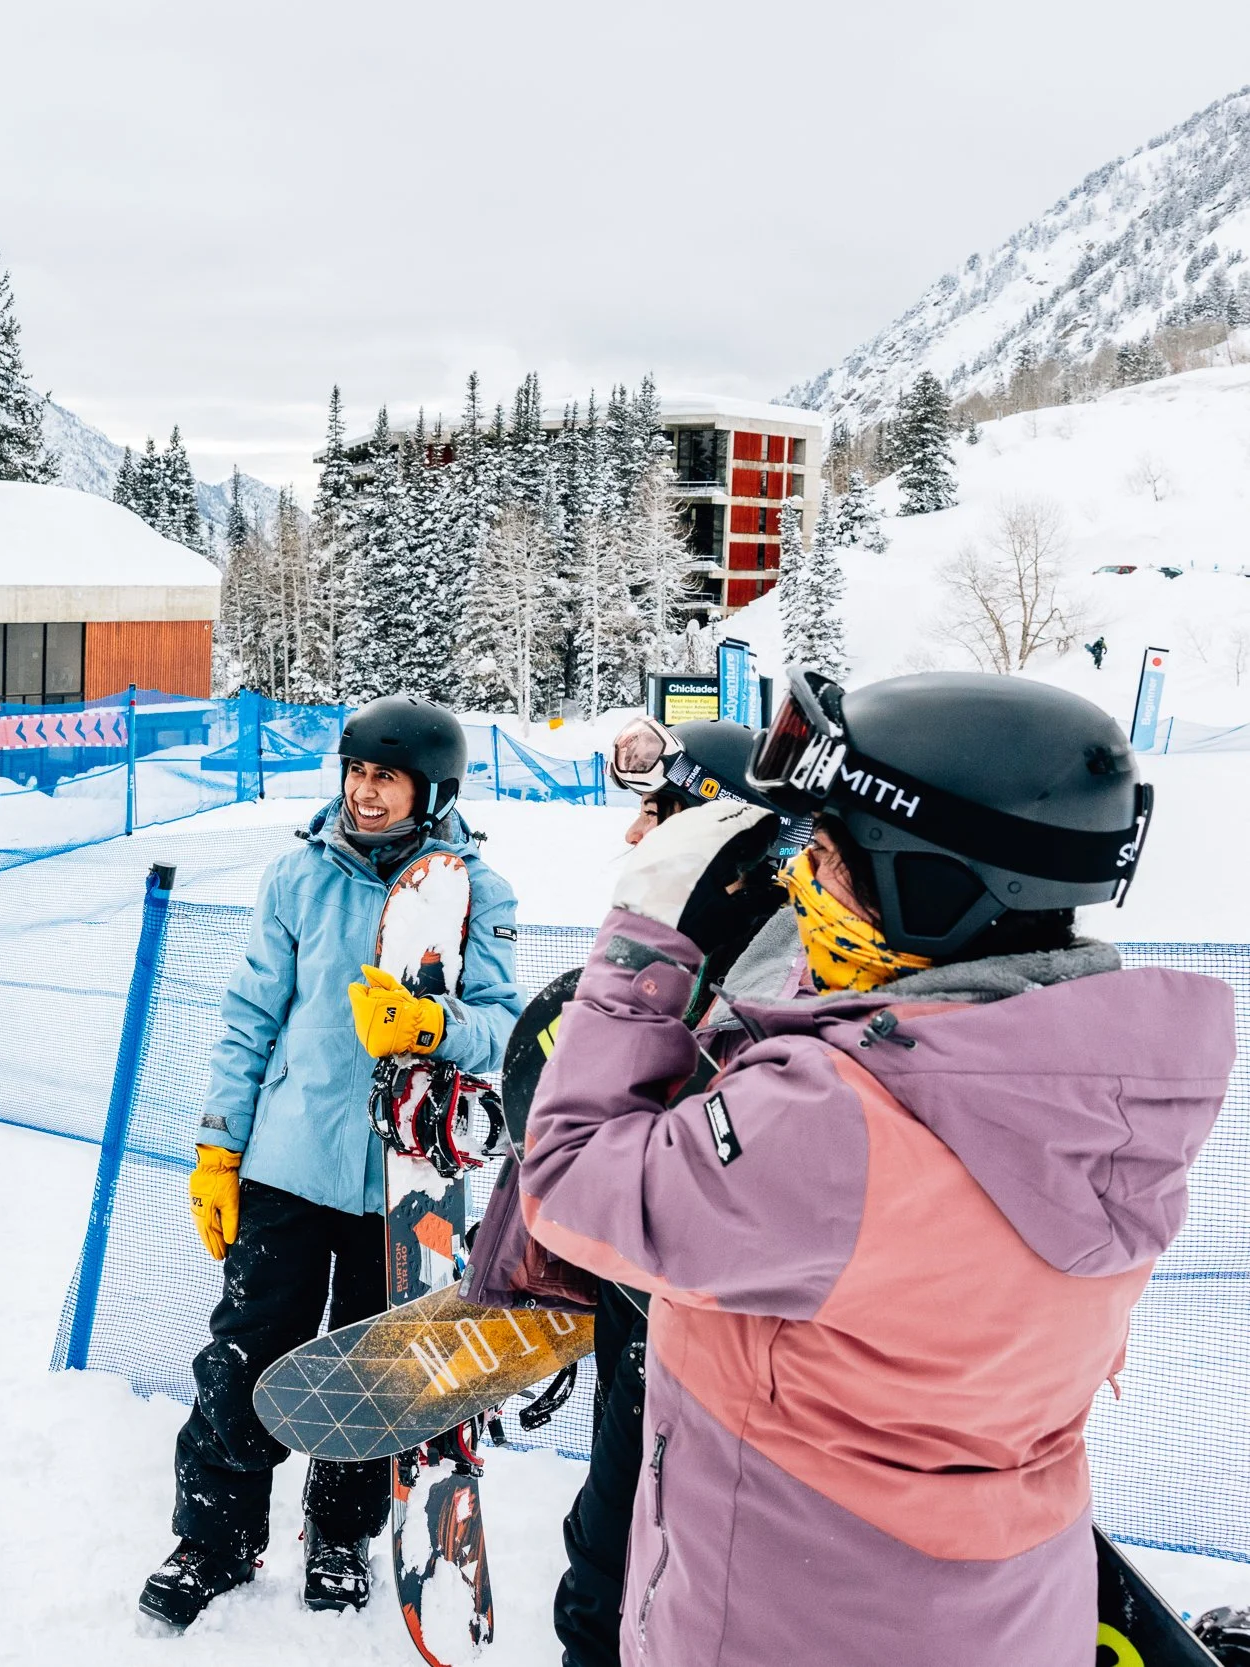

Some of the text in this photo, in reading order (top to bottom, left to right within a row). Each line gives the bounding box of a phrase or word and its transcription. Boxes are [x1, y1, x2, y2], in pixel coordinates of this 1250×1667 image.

[668, 684, 718, 693] Chickadee
[724, 653, 739, 721] Adventure
[1141, 677, 1157, 726] Beginner
[840, 763, 920, 818] MITH
[779, 847, 796, 856] anon
